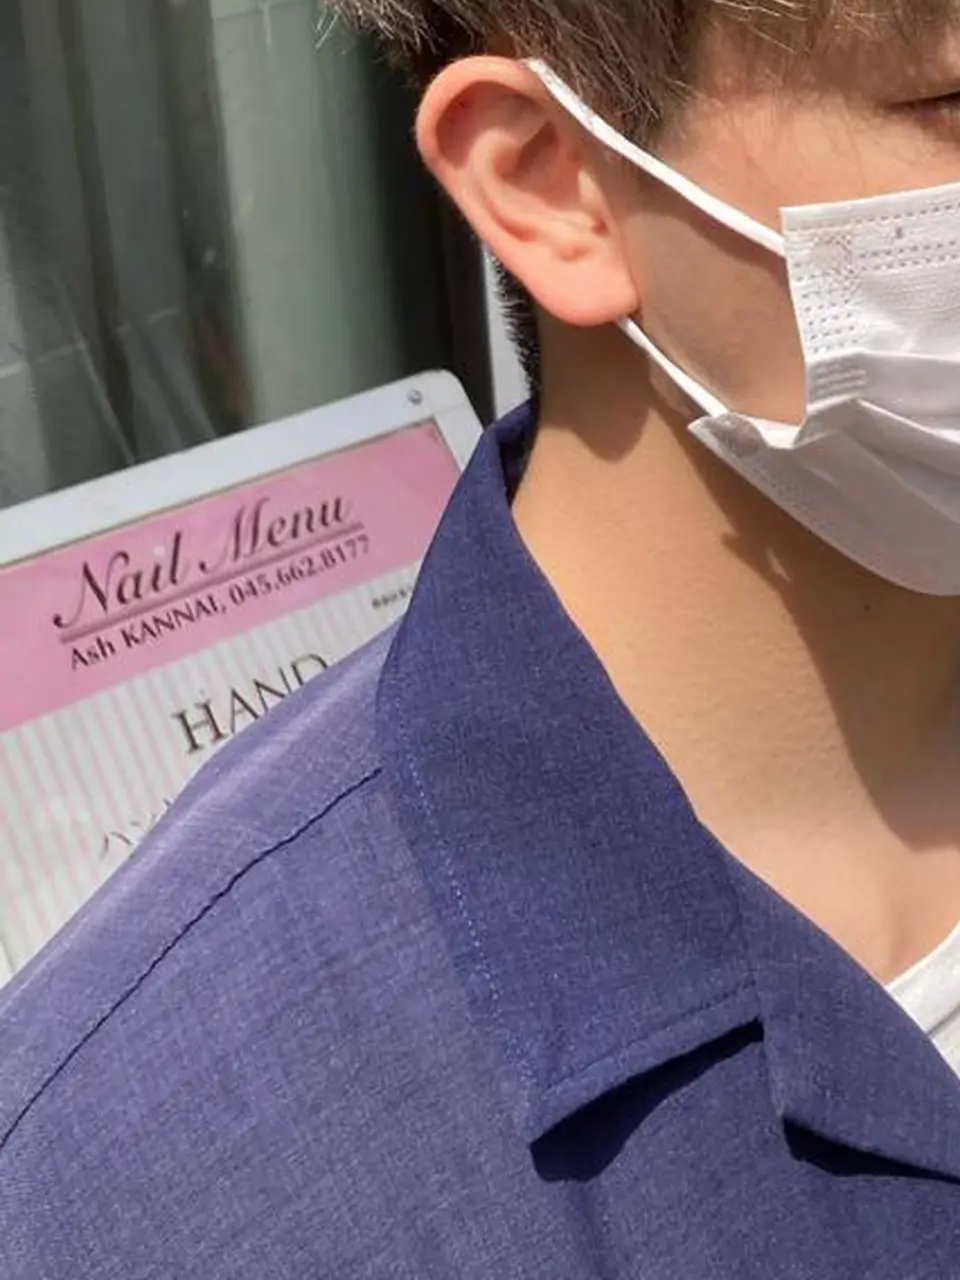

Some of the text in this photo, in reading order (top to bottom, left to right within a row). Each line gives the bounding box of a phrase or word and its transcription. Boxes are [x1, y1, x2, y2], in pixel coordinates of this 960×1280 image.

[52, 496, 353, 629] Nail Menu
[71, 636, 117, 671] Ash
[228, 532, 370, 606] 045.662.8177
